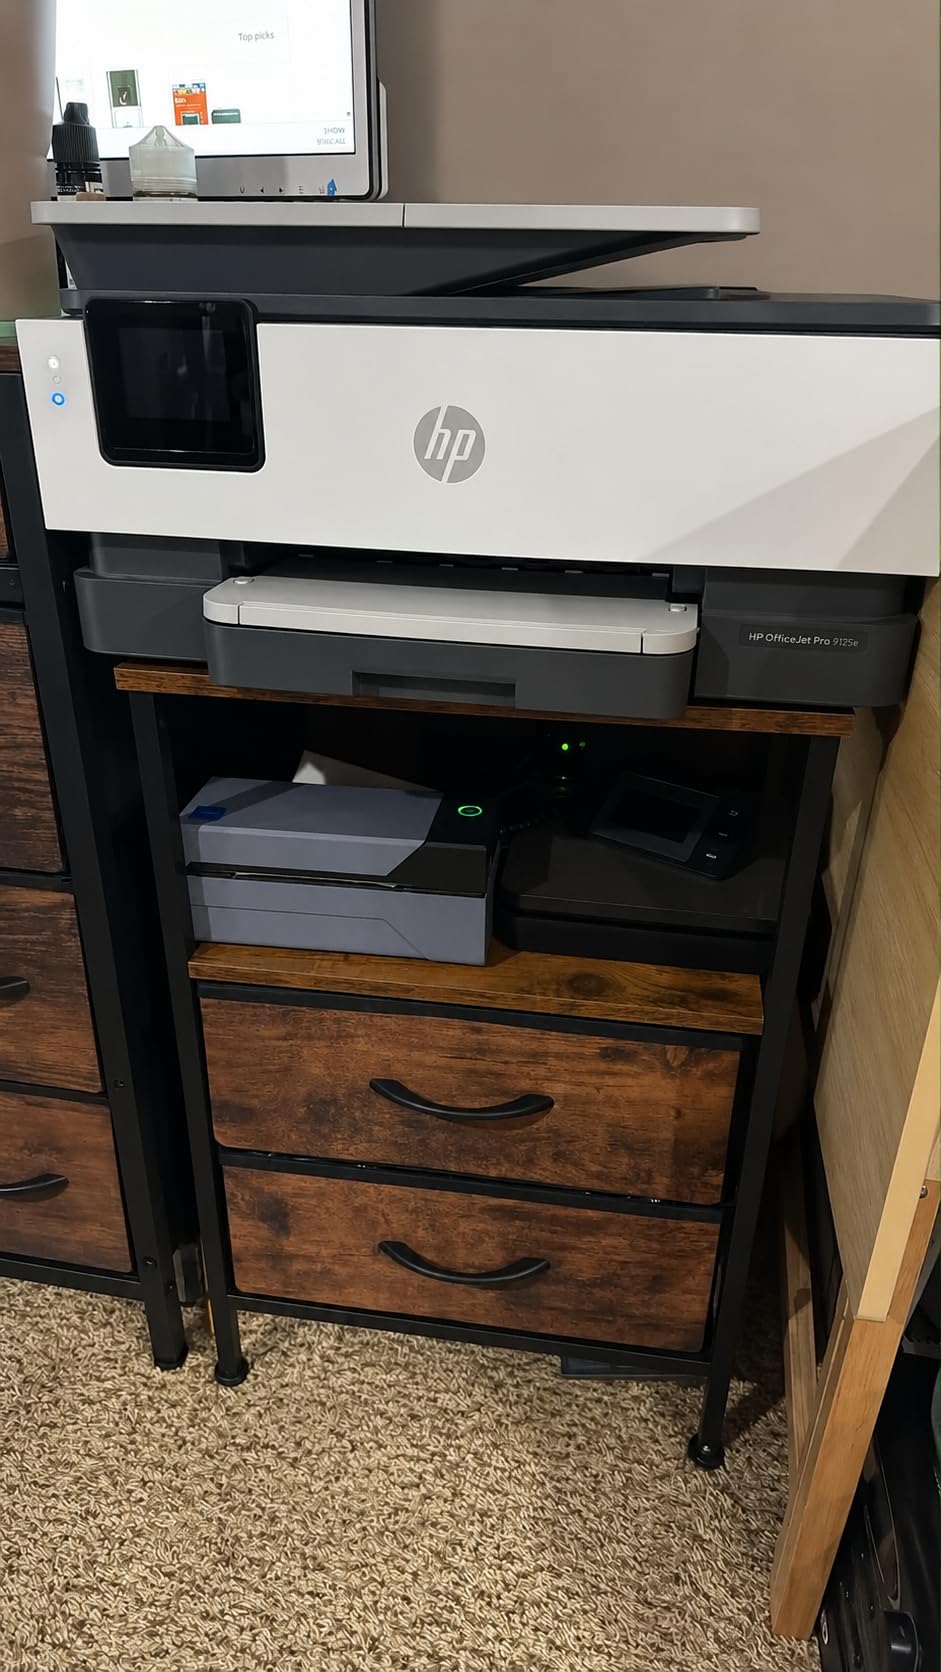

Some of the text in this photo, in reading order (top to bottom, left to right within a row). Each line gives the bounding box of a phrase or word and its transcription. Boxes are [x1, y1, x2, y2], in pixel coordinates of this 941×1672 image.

[238, 32, 275, 43] Top picks
[422, 401, 477, 484] hp
[748, 632, 859, 647] HP OfficeJet Pro 9125e
